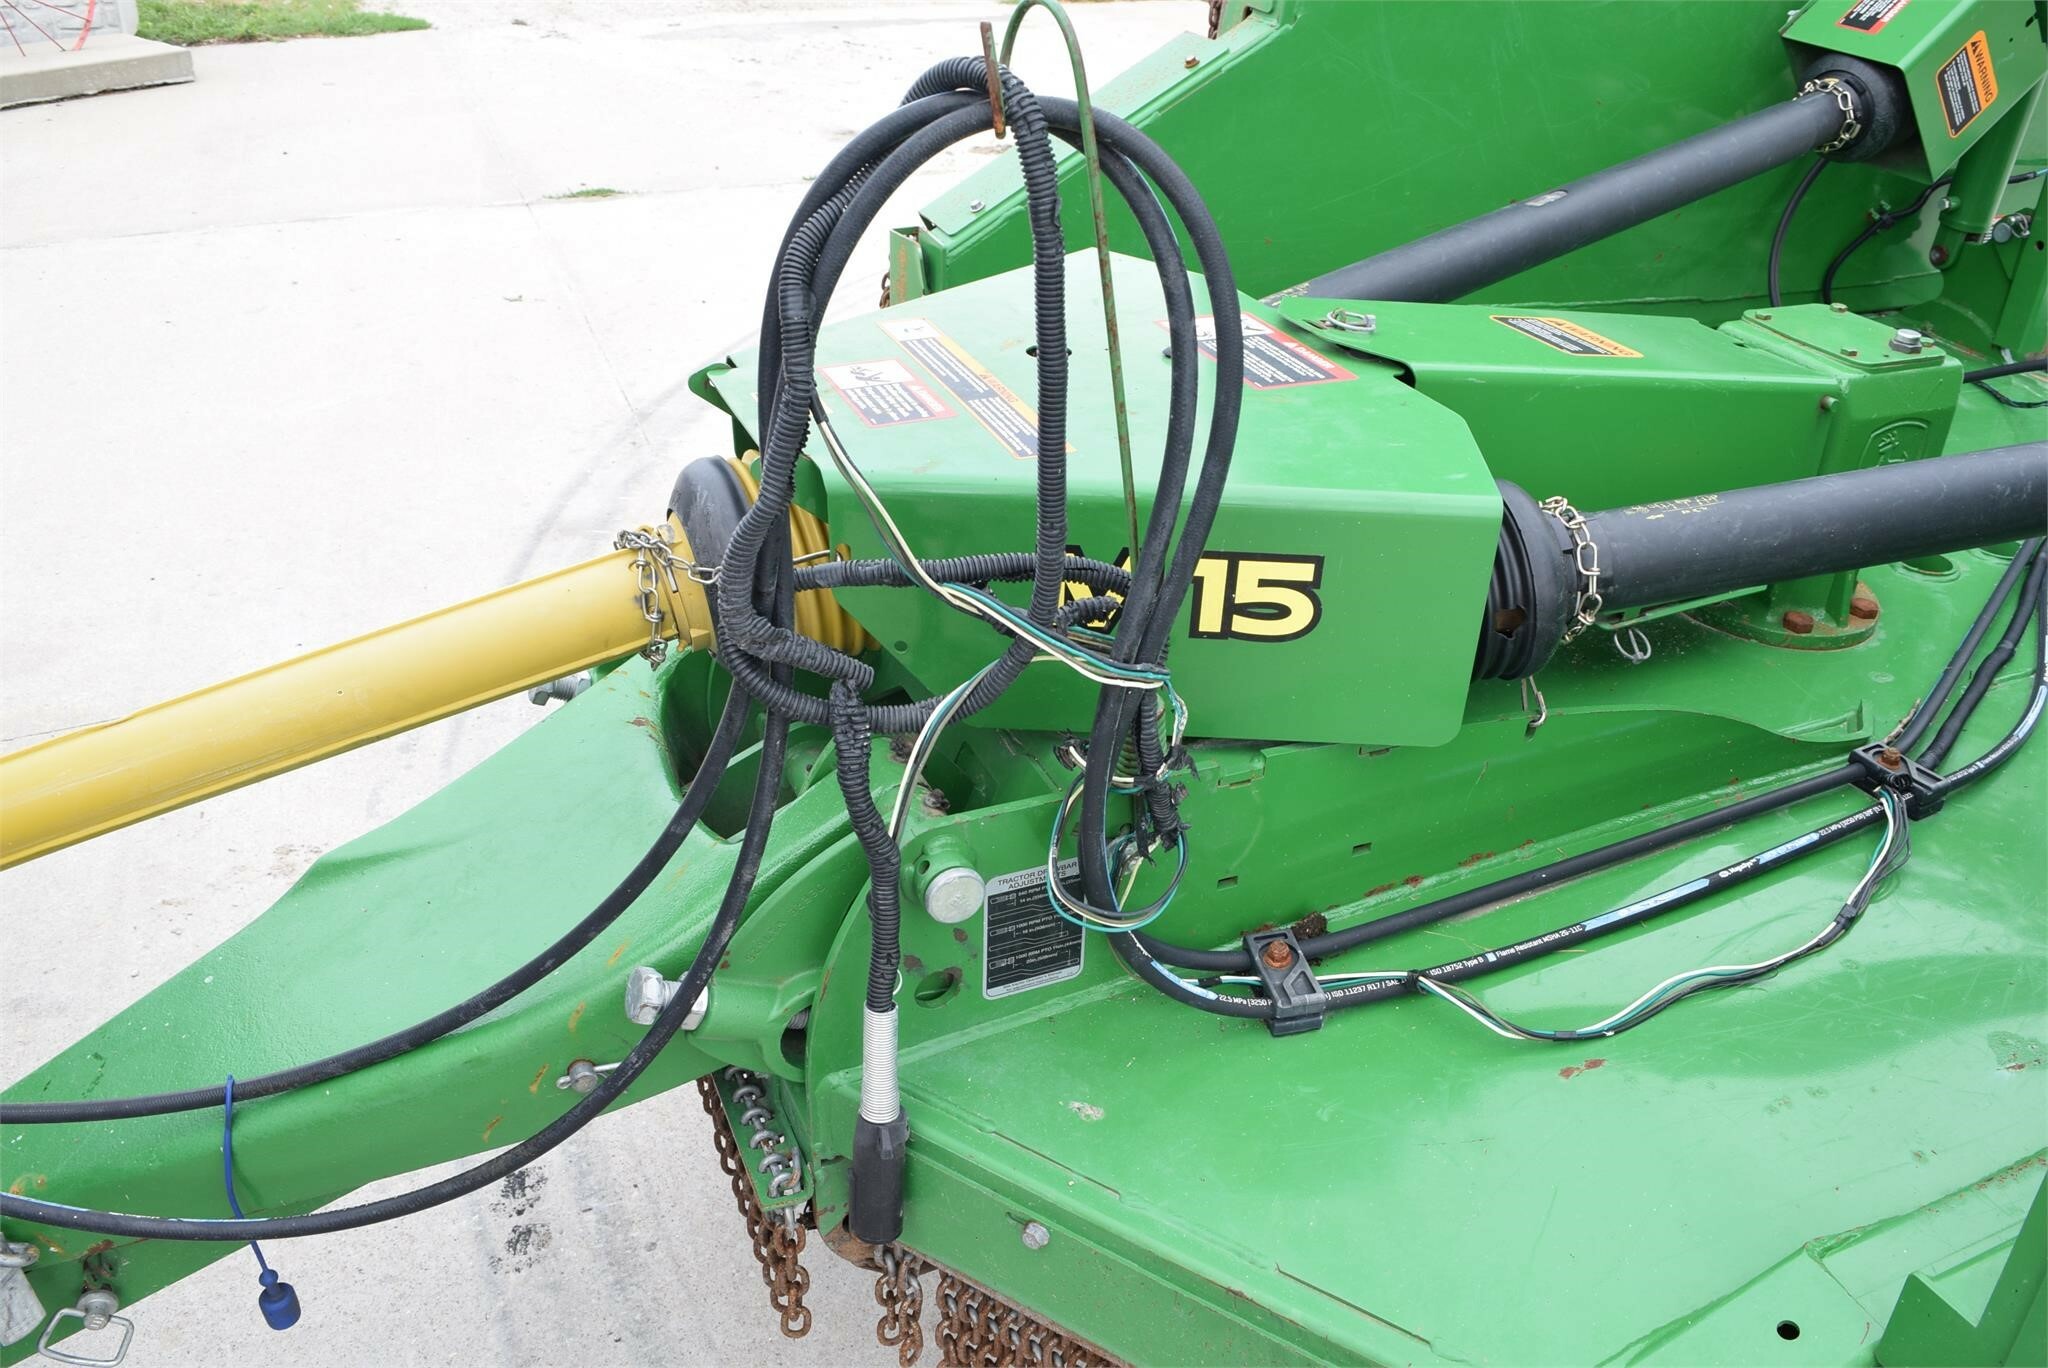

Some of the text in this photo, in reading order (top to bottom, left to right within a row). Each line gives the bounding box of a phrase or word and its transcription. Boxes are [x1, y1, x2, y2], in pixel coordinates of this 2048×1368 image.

[1974, 46, 1993, 103] WARNING
[1564, 325, 1634, 356] WARNING
[1299, 344, 1336, 369] DANGER
[997, 871, 1035, 886] TRACTOR
[1041, 915, 1053, 923] PTO
[1041, 946, 1053, 954] PTO
[1496, 948, 1516, 958] Flame
[1514, 938, 1544, 953] Resistant
[1542, 932, 1561, 943] MSHA
[1430, 967, 1442, 976] ISO
[1443, 962, 1463, 973] 18752
[1462, 958, 1478, 969] Type
[1331, 990, 1344, 998] ISO
[1345, 985, 1366, 996] 11237
[1367, 982, 1381, 992] R17
